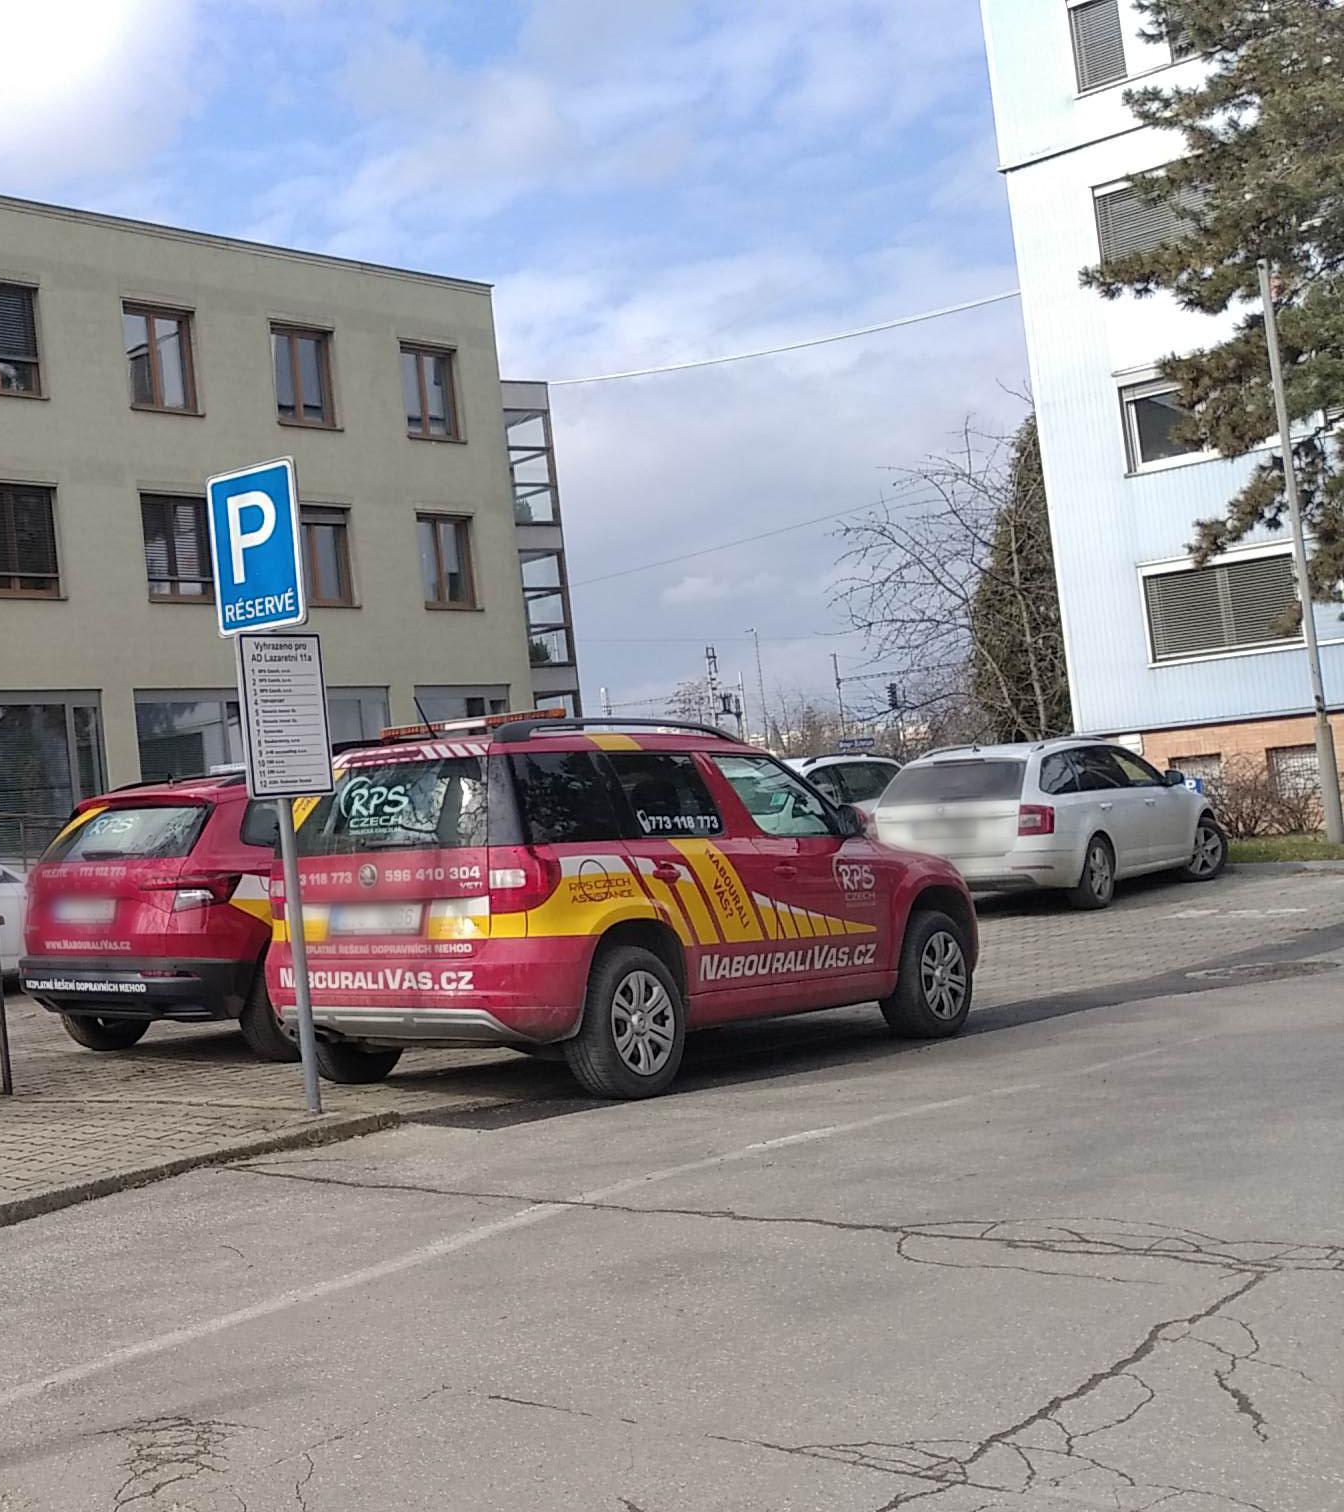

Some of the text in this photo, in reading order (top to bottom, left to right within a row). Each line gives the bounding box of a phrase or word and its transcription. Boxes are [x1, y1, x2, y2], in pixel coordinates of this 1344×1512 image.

[227, 490, 276, 585] P
[225, 588, 296, 623] RÉSERVÉ
[254, 641, 307, 652] Vyhrazeno pro
[251, 654, 263, 662] AD
[300, 653, 312, 662] 11a
[350, 784, 411, 817] RPS
[349, 814, 403, 828] CZECH
[648, 815, 719, 829] 773 118 773
[309, 873, 327, 885] 118
[331, 871, 352, 884] 773
[385, 869, 411, 882] 596
[416, 868, 444, 880] 410
[449, 866, 480, 880] 304
[594, 878, 631, 890] CZECH
[838, 864, 876, 891] RPS
[705, 848, 751, 930] NABOURALI
[712, 878, 734, 920] VÁS?
[434, 943, 472, 953] NEHOD
[76, 981, 119, 992] DOPRAVNÍCH
[118, 983, 147, 993] NEHOD
[279, 967, 474, 991] NBOURALIVAS.CZ
